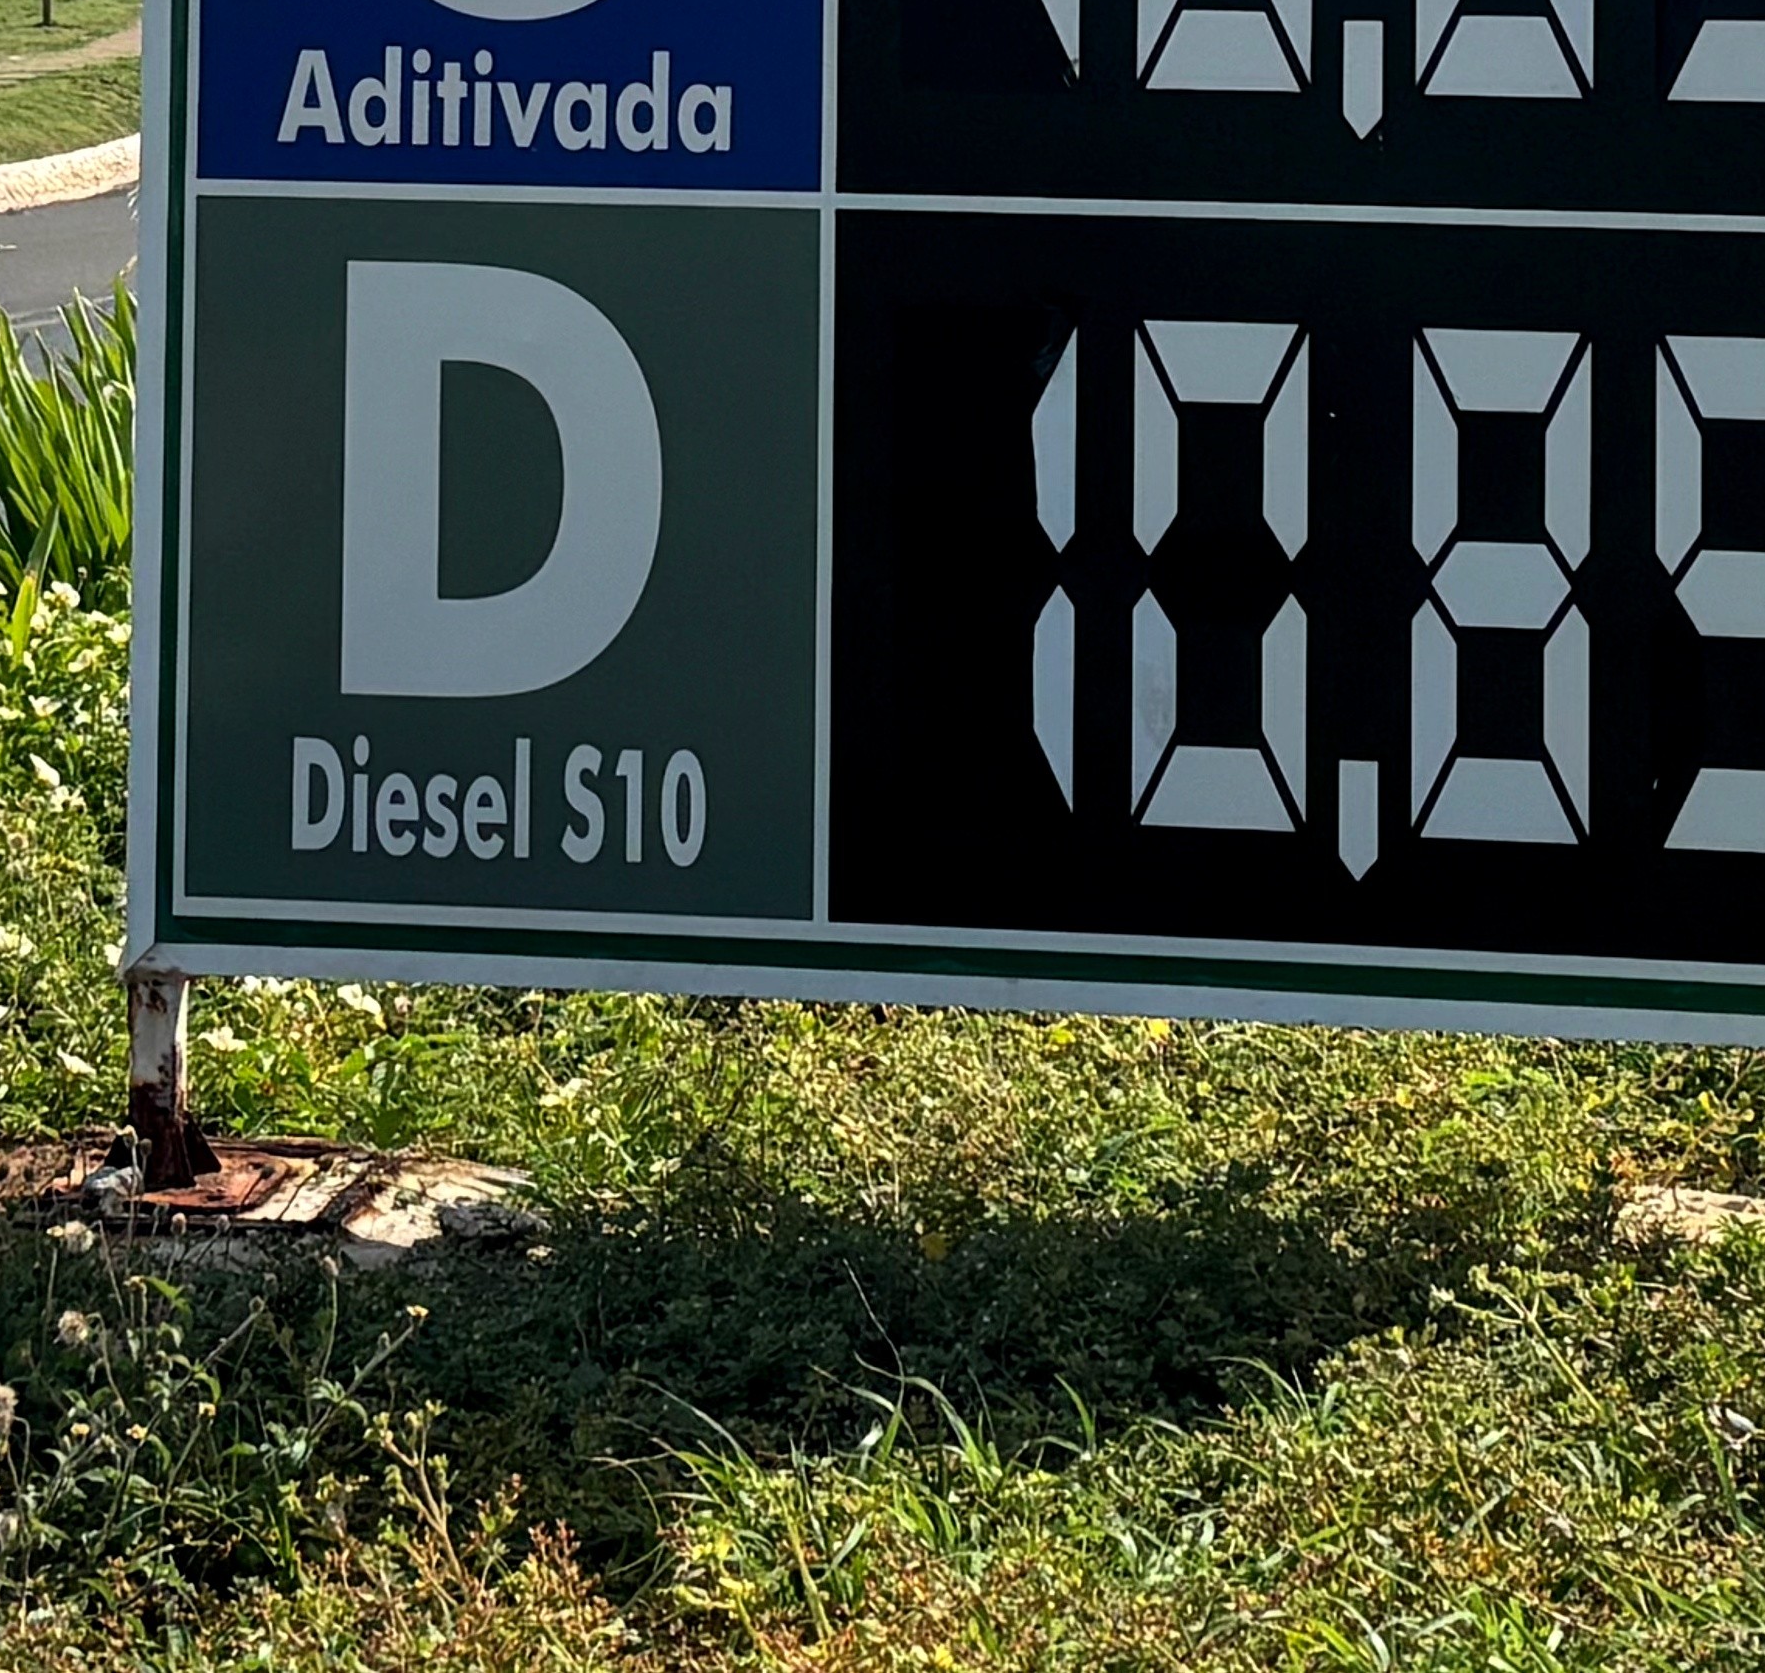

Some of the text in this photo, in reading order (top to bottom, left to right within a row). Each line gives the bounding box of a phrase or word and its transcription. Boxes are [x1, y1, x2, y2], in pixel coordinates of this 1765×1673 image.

[276, 45, 732, 153] Aditivada
[340, 259, 663, 698] D
[291, 734, 706, 867] Diesel S10
